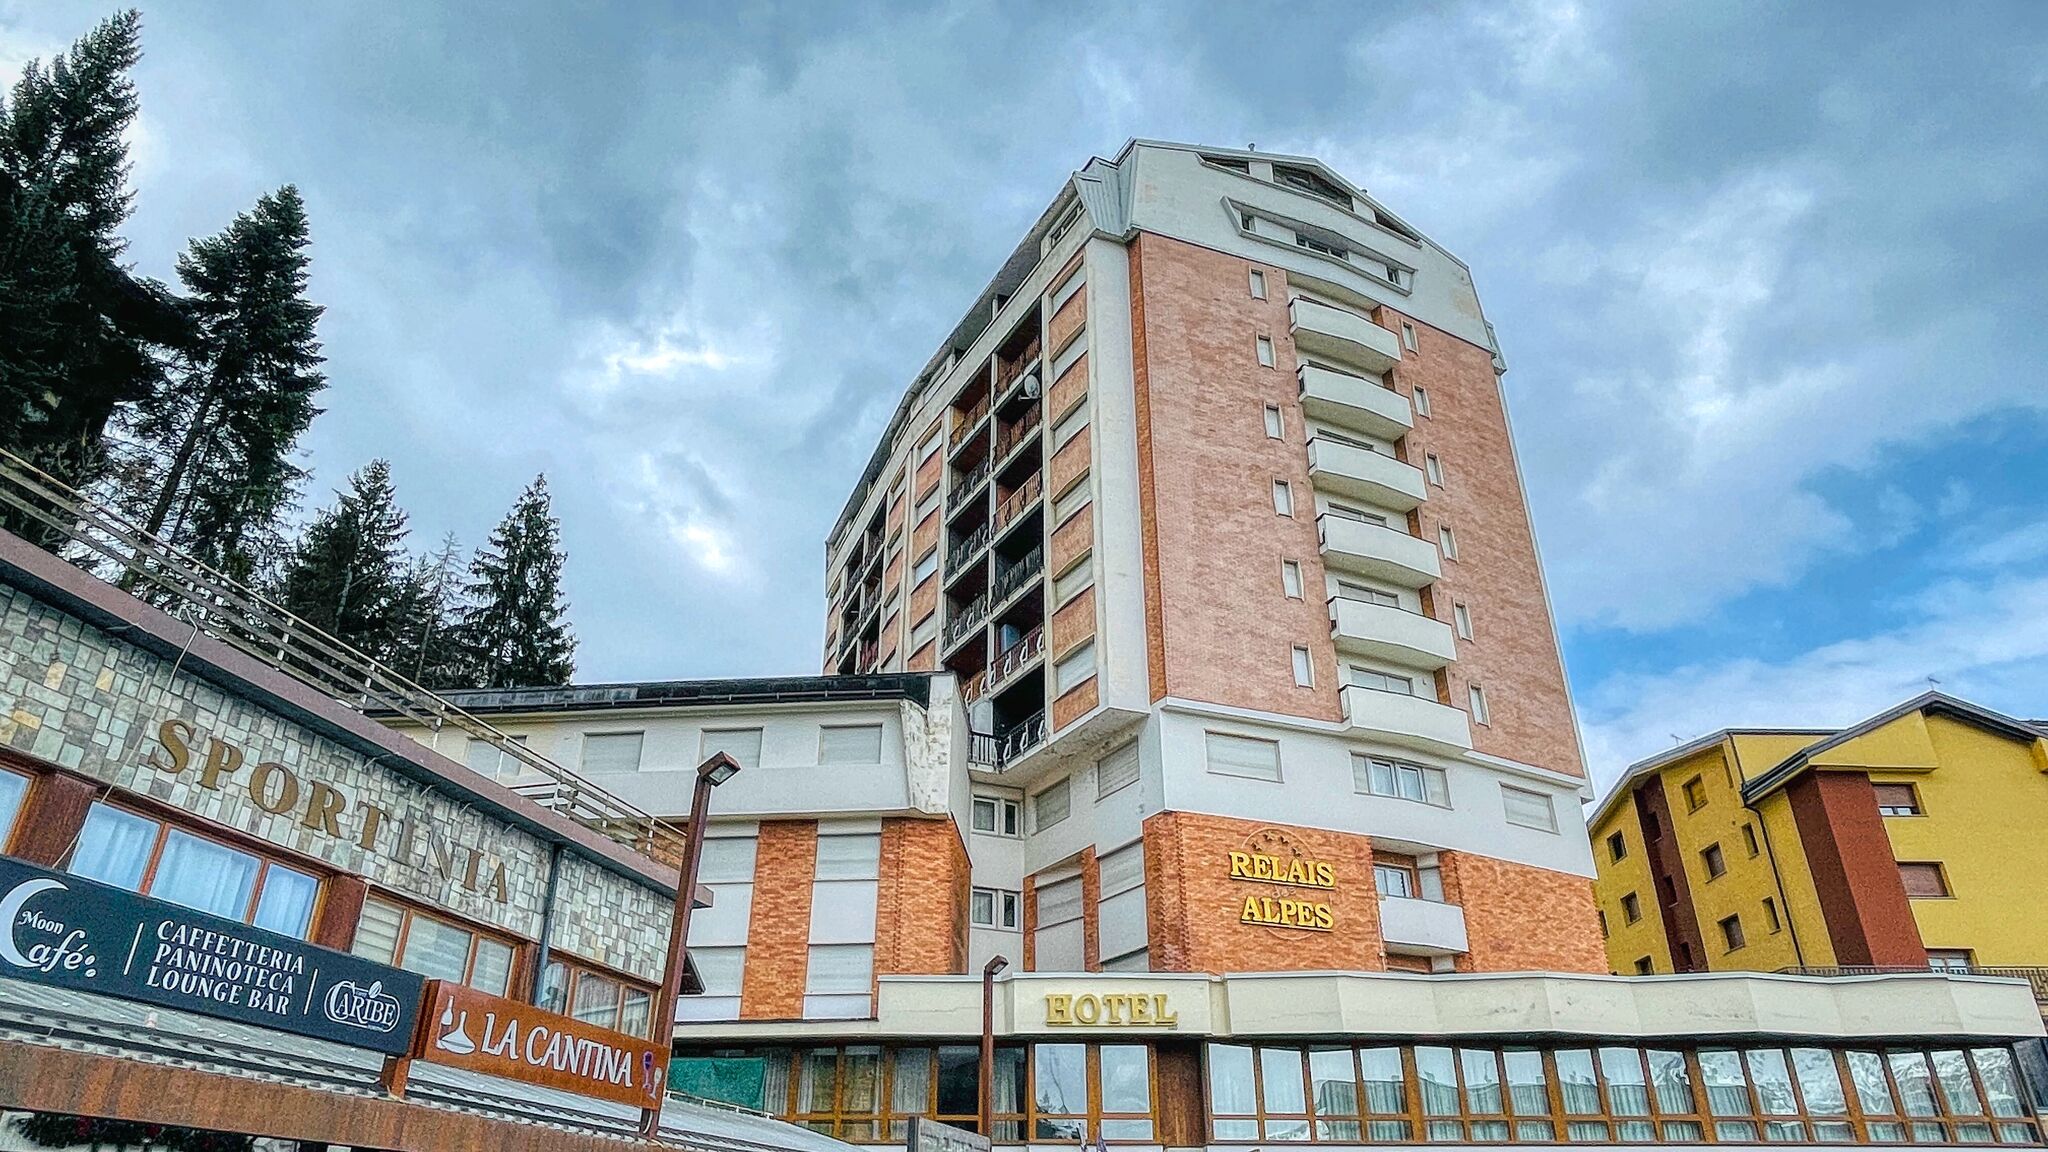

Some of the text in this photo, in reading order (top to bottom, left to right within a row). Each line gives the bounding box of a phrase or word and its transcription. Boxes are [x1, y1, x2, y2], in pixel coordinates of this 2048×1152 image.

[147, 718, 509, 904] SPORTINIA
[1229, 851, 1336, 888] RELAIS
[18, 910, 65, 936] Moon
[1241, 895, 1335, 930] ALPES
[153, 943, 295, 995] PANINOTECA
[156, 920, 304, 975] CAFFETTERIA
[145, 965, 291, 1016] LOUNGE BAR
[329, 981, 397, 1028] CARIBE
[1045, 993, 1178, 1025] HOTEL
[480, 1012, 634, 1088] LA CANTINA
